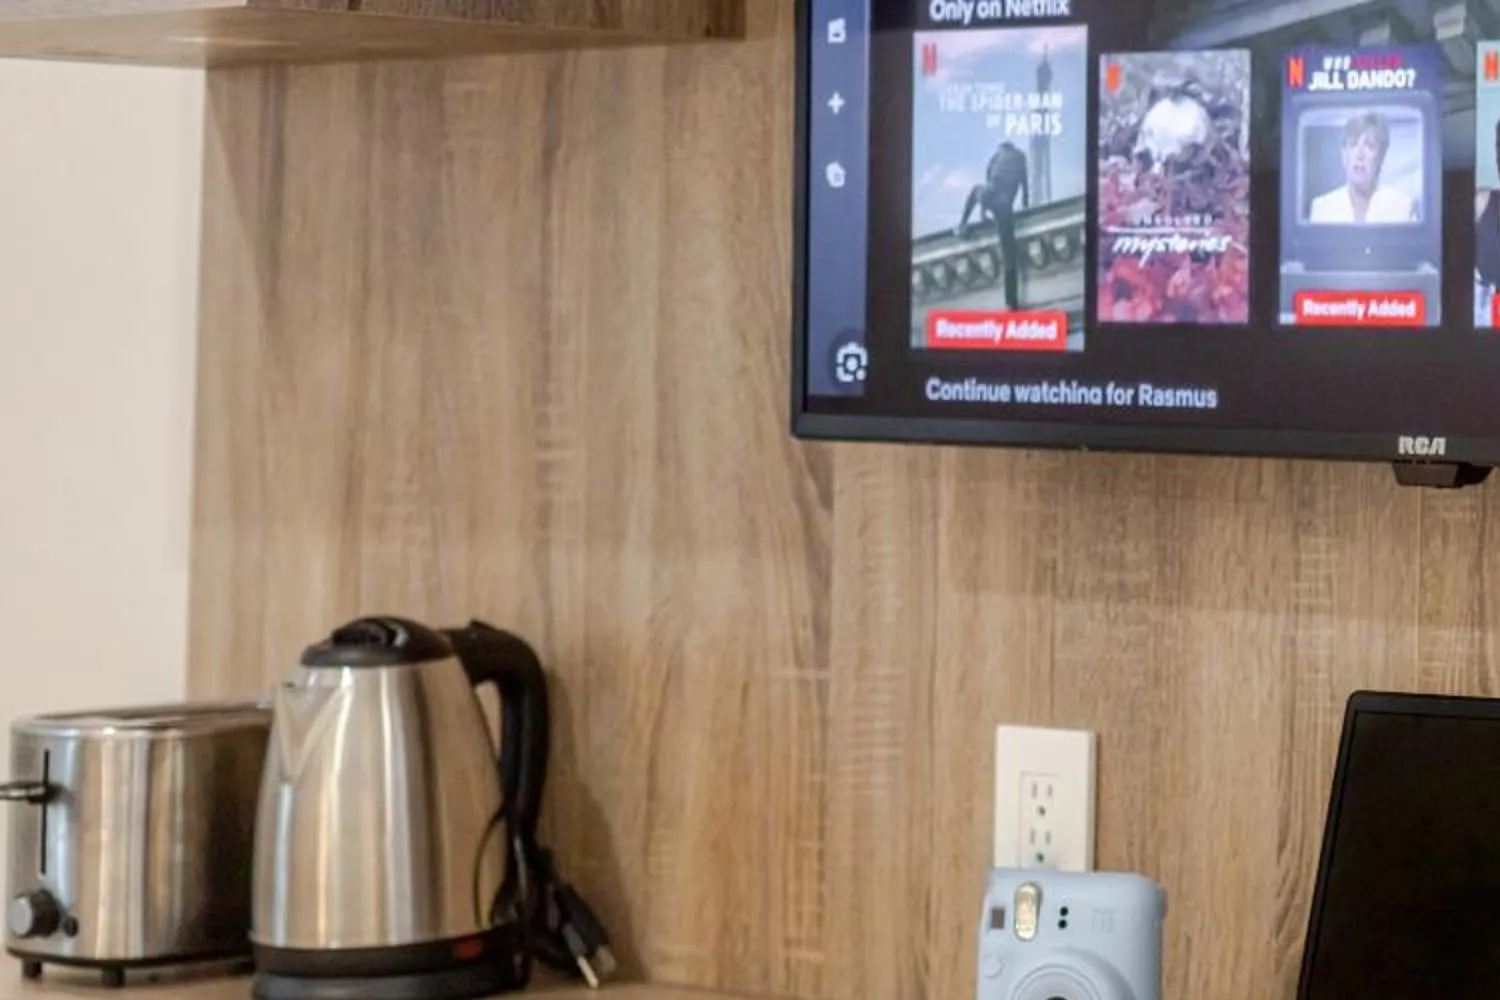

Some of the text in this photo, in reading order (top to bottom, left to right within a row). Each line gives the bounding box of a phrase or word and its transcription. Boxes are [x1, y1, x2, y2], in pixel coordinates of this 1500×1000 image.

[929, 0, 1070, 25] Only on Netflix
[1308, 68, 1416, 91] JILL DANDO?
[1004, 112, 1062, 136] PARIS
[1112, 233, 1233, 268] mysteries
[1303, 299, 1417, 319] Recently Added
[935, 319, 1058, 342] Recently Added
[925, 378, 1012, 402] Continue
[1106, 382, 1135, 406] for
[1138, 384, 1218, 408] Rasmus
[1399, 436, 1446, 455] RCA
